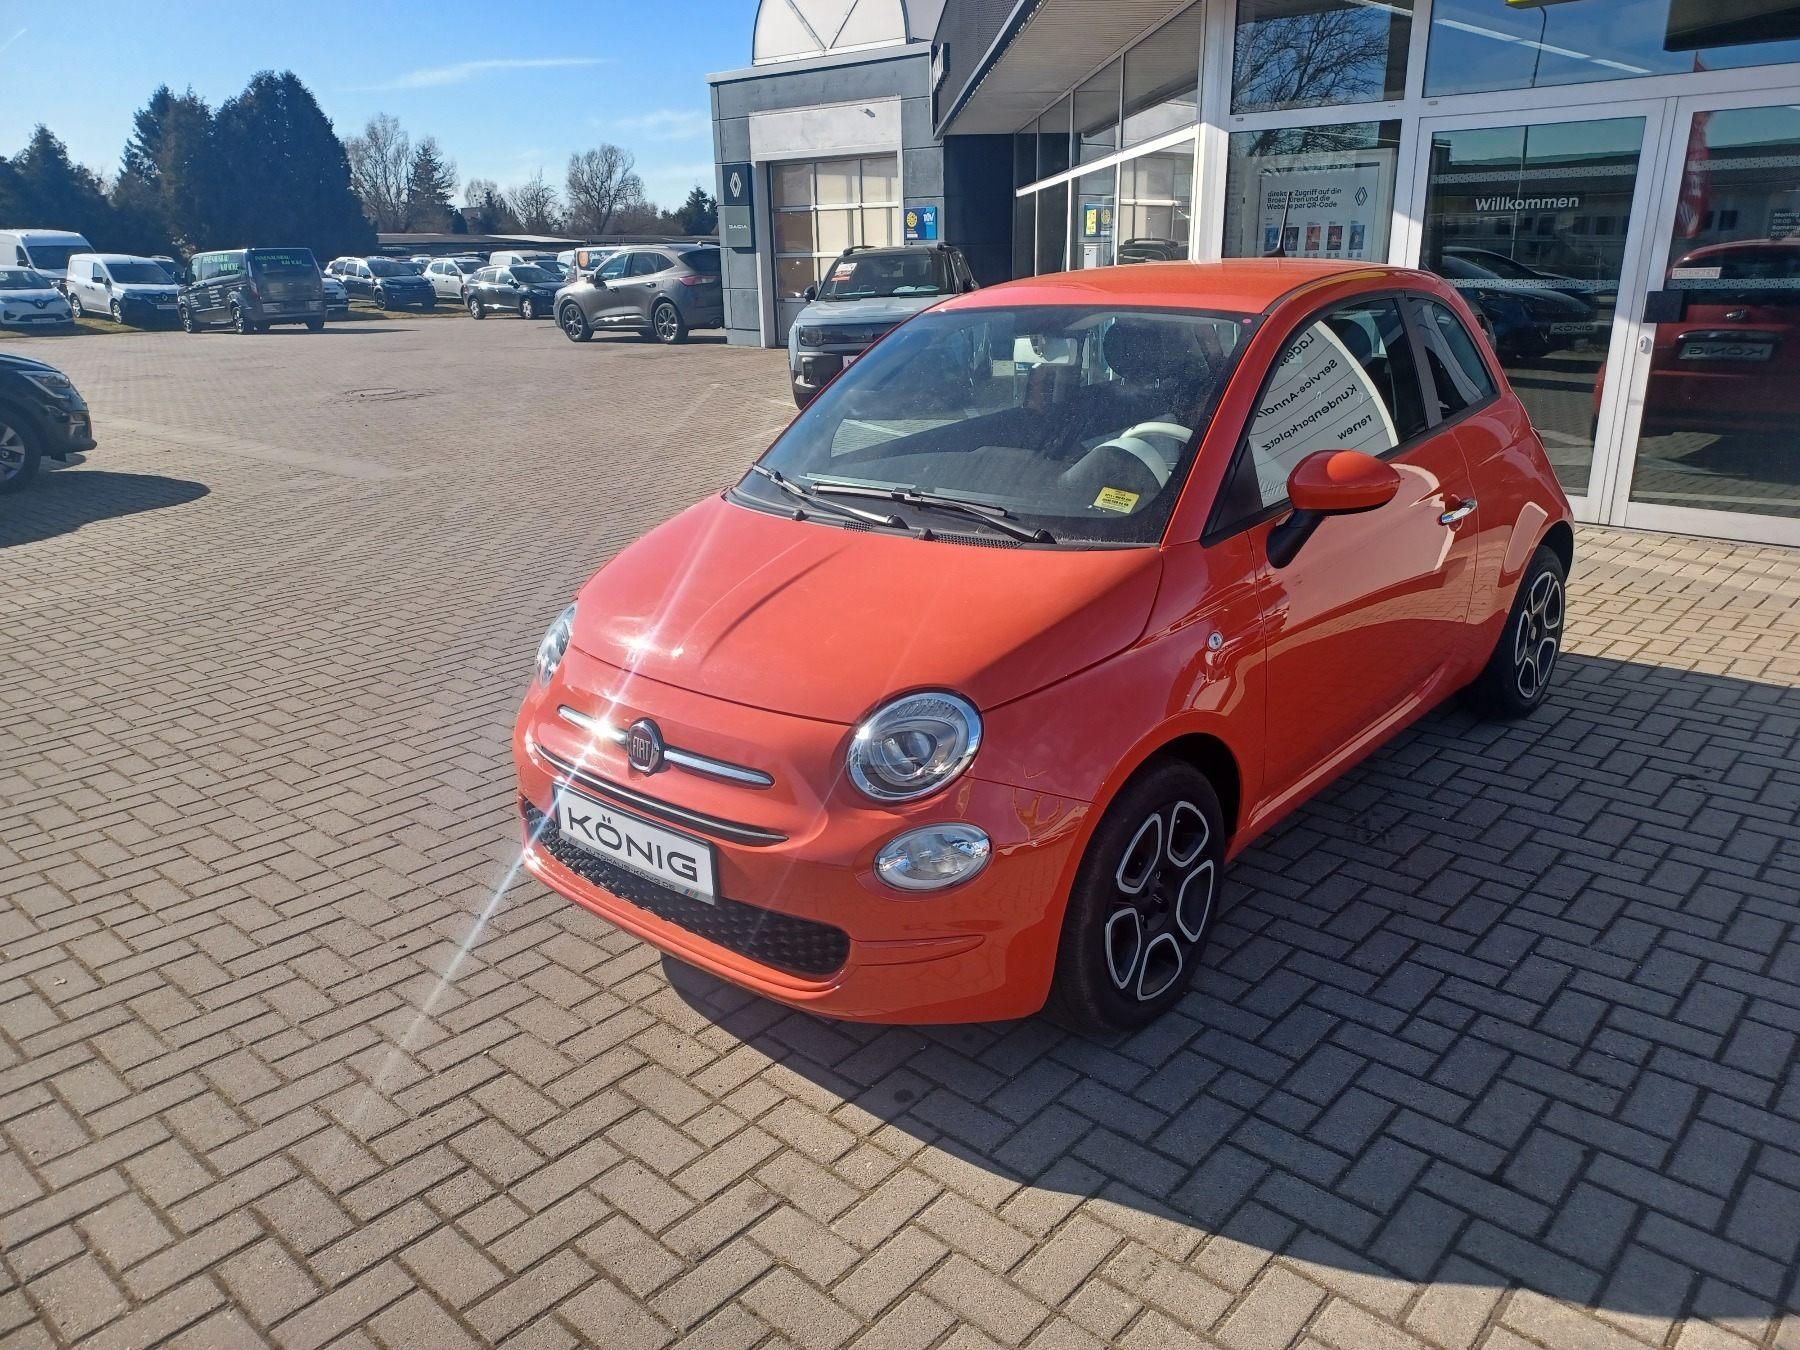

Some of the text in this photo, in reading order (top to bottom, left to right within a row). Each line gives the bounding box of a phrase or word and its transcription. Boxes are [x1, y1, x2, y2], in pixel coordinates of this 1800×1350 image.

[1294, 188, 1318, 197] Zugriff
[1475, 196, 1579, 211] Willkommen
[632, 735, 651, 761] FIAT
[567, 806, 698, 883] KÖNIG
